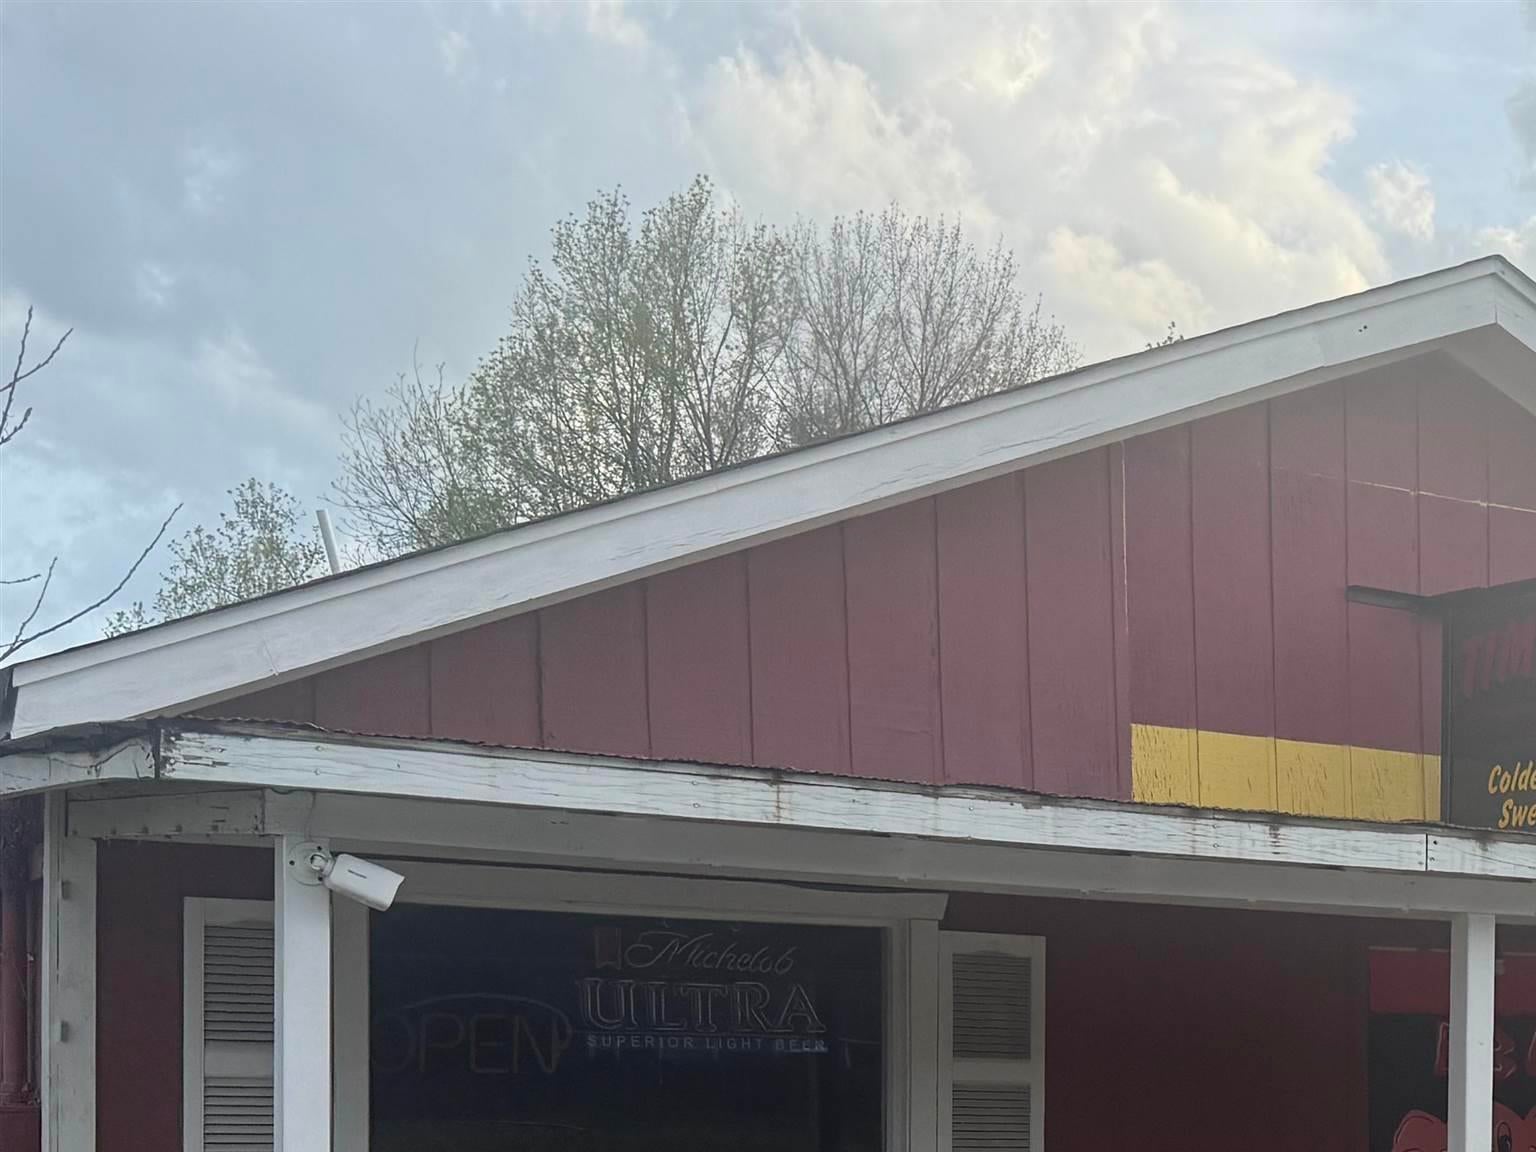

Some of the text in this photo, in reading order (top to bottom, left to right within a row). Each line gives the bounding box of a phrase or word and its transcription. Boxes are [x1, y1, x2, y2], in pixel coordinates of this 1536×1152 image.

[623, 930, 799, 976] Michelob
[576, 977, 827, 1034] ULTRA
[586, 1034, 827, 1052] SUPERIOR LIGHT BEER
